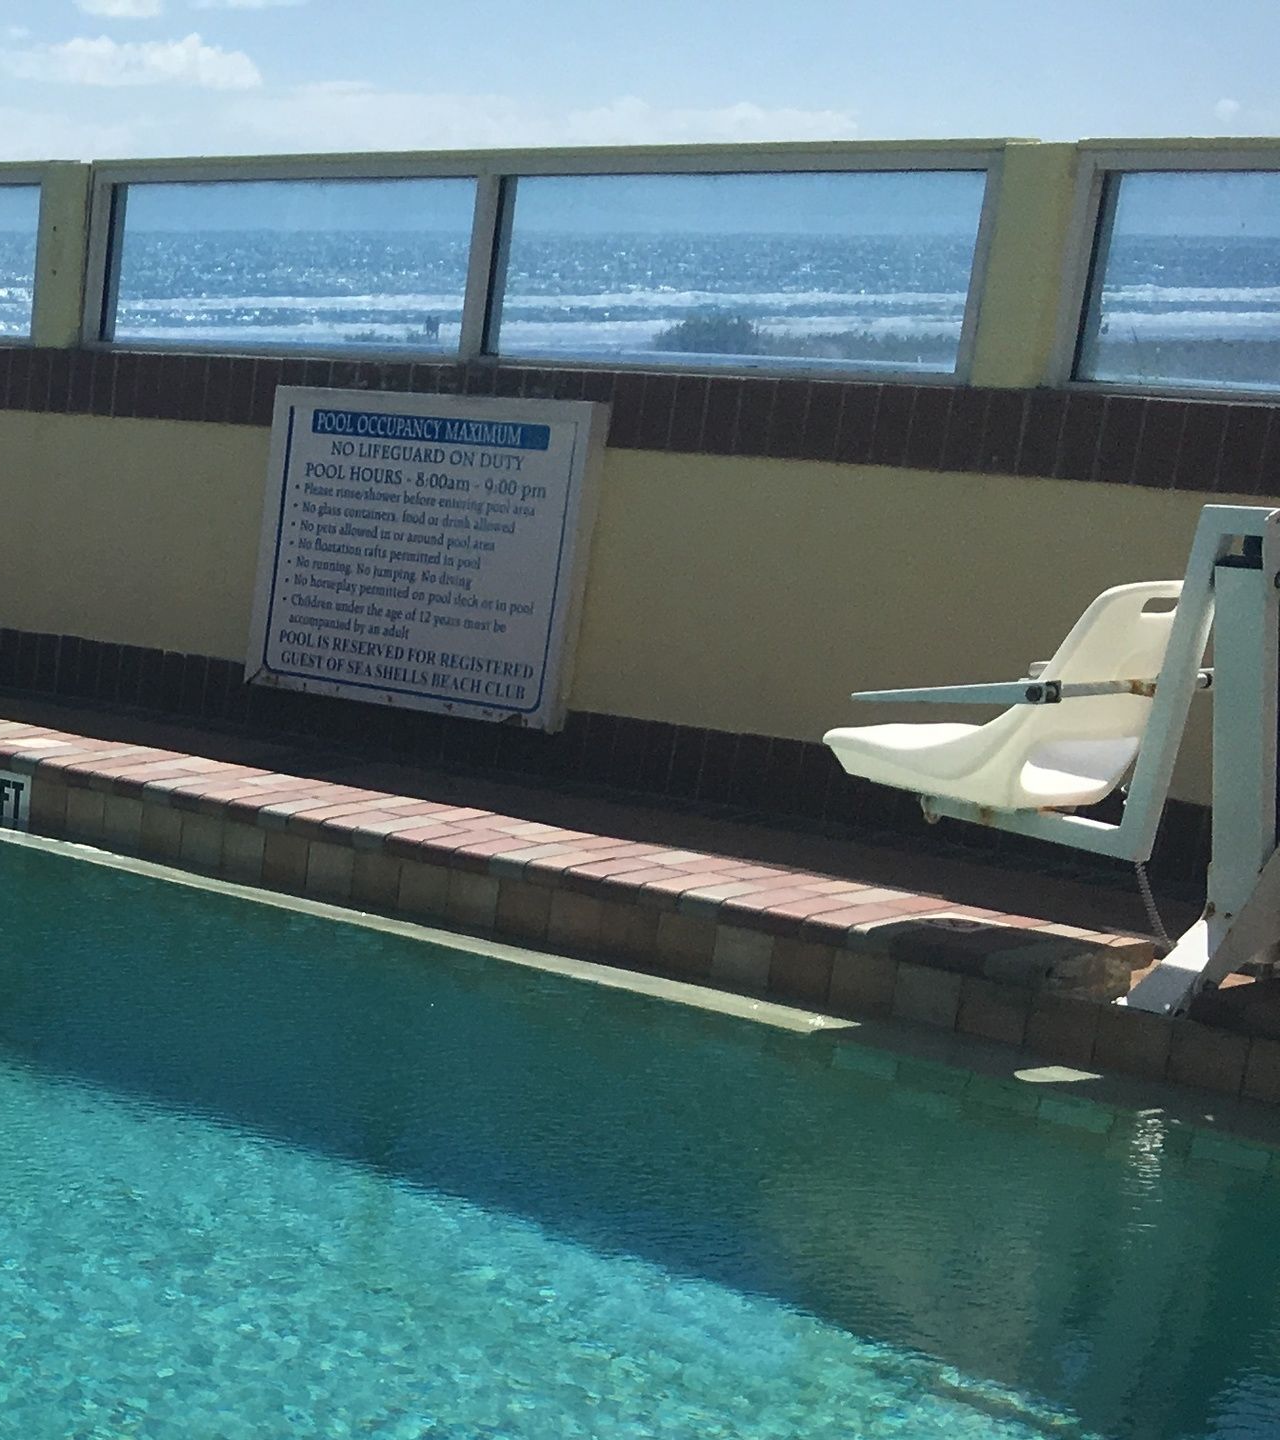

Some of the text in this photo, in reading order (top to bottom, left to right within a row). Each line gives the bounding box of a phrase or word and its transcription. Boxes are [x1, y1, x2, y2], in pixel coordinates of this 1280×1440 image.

[317, 412, 521, 445] POOL OCCUPANCY MAXIMUM
[331, 441, 525, 471] NO LIFEGUARD ON DUTY
[305, 462, 345, 480] POOL
[350, 466, 402, 485] HOURS
[415, 471, 470, 492] 8:00am
[484, 478, 518, 495] 9:00
[521, 485, 546, 501] pm
[304, 482, 334, 497] Please
[403, 490, 437, 506] before
[439, 499, 483, 514] entering
[486, 499, 511, 516] pool
[513, 505, 535, 516] area
[302, 501, 317, 513] No
[318, 502, 341, 517] glass
[403, 509, 426, 526] food
[428, 516, 439, 526] or
[442, 513, 471, 529] drink
[473, 516, 515, 534] allowed
[301, 520, 495, 552] No pets allowed in or around pool area
[298, 538, 313, 550] No
[364, 545, 387, 558] rafts
[389, 551, 441, 566] permitted
[443, 554, 454, 566] in
[456, 557, 481, 571] pool
[296, 556, 310, 568] No
[356, 563, 371, 576] No
[421, 571, 437, 583] No
[439, 572, 473, 591] diving
[294, 574, 308, 586] No
[359, 584, 410, 599] permitted
[411, 591, 425, 601] on
[427, 590, 452, 606] pool
[454, 593, 479, 608] deck
[481, 600, 494, 610] or
[496, 600, 507, 612] in
[509, 602, 535, 616] pool
[288, 614, 410, 640] accompanied by an adult
[291, 593, 507, 633] Children under the age of 12 years must be
[279, 629, 535, 680] POOL IS RESERVED FOR REGISTERED
[281, 650, 527, 700] GUEST OF SEA SHELLS BEACH CLUB
